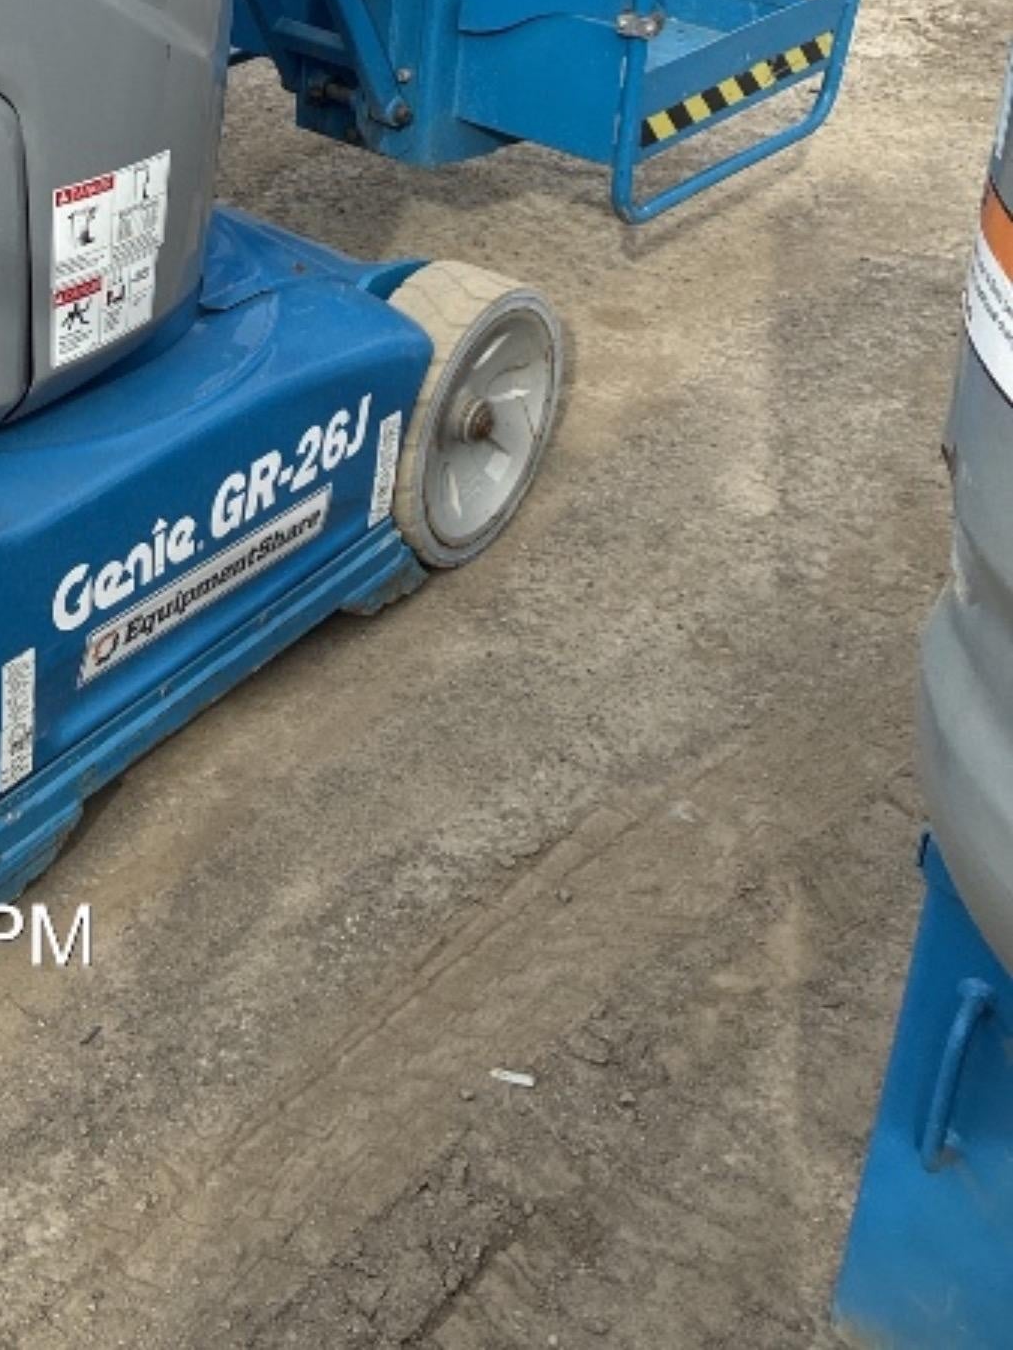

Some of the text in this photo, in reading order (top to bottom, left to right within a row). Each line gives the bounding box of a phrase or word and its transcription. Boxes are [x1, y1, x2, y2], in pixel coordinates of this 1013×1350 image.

[52, 515, 197, 632] Genie
[210, 392, 373, 539] GR-26J
[124, 508, 322, 645] EquipmentShare
